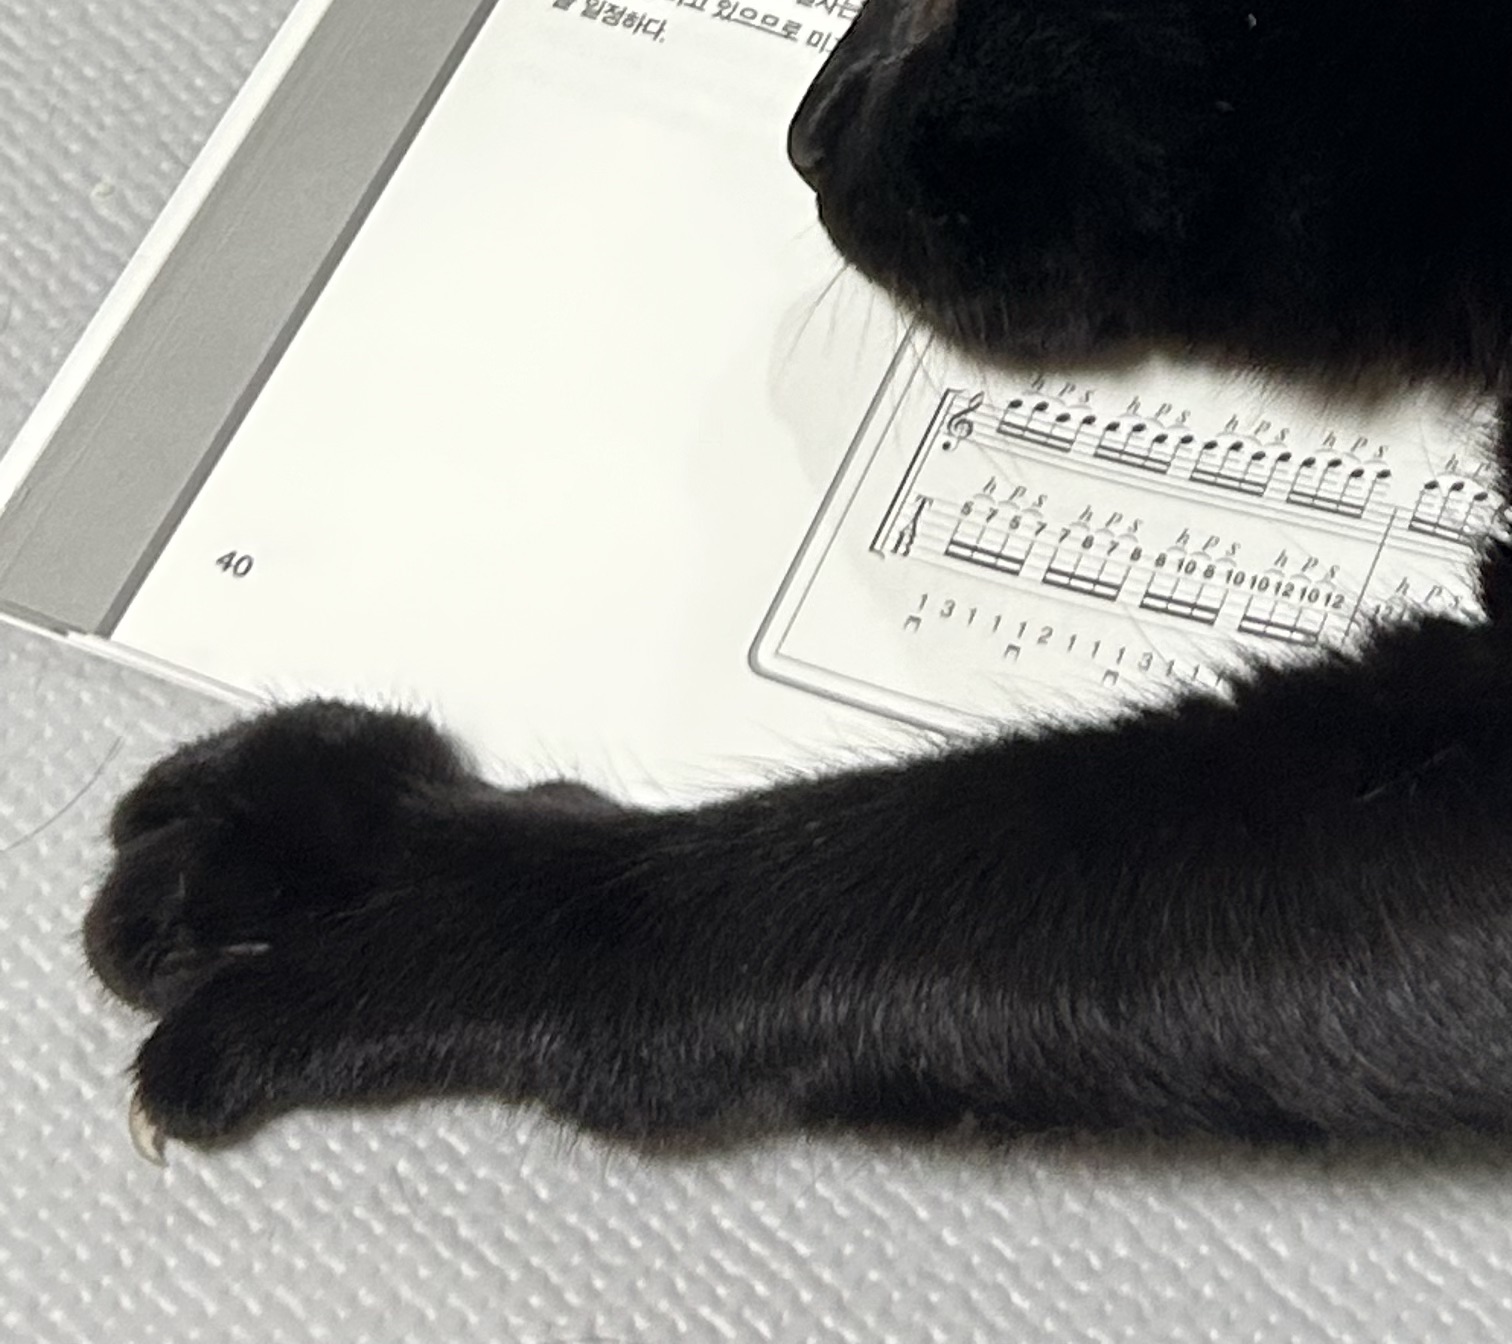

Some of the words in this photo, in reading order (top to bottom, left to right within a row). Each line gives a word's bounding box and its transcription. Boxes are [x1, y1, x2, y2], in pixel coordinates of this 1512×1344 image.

[711, 0, 803, 42] 있으므로
[215, 549, 255, 579] 40
[1177, 557, 1197, 575] 10
[1225, 567, 1246, 586] 10
[1250, 573, 1270, 592] 10
[1274, 579, 1295, 598] 12
[1299, 585, 1320, 604] 10
[1324, 591, 1345, 609] 12
[939, 598, 956, 619] 3
[1036, 625, 1054, 645] 2
